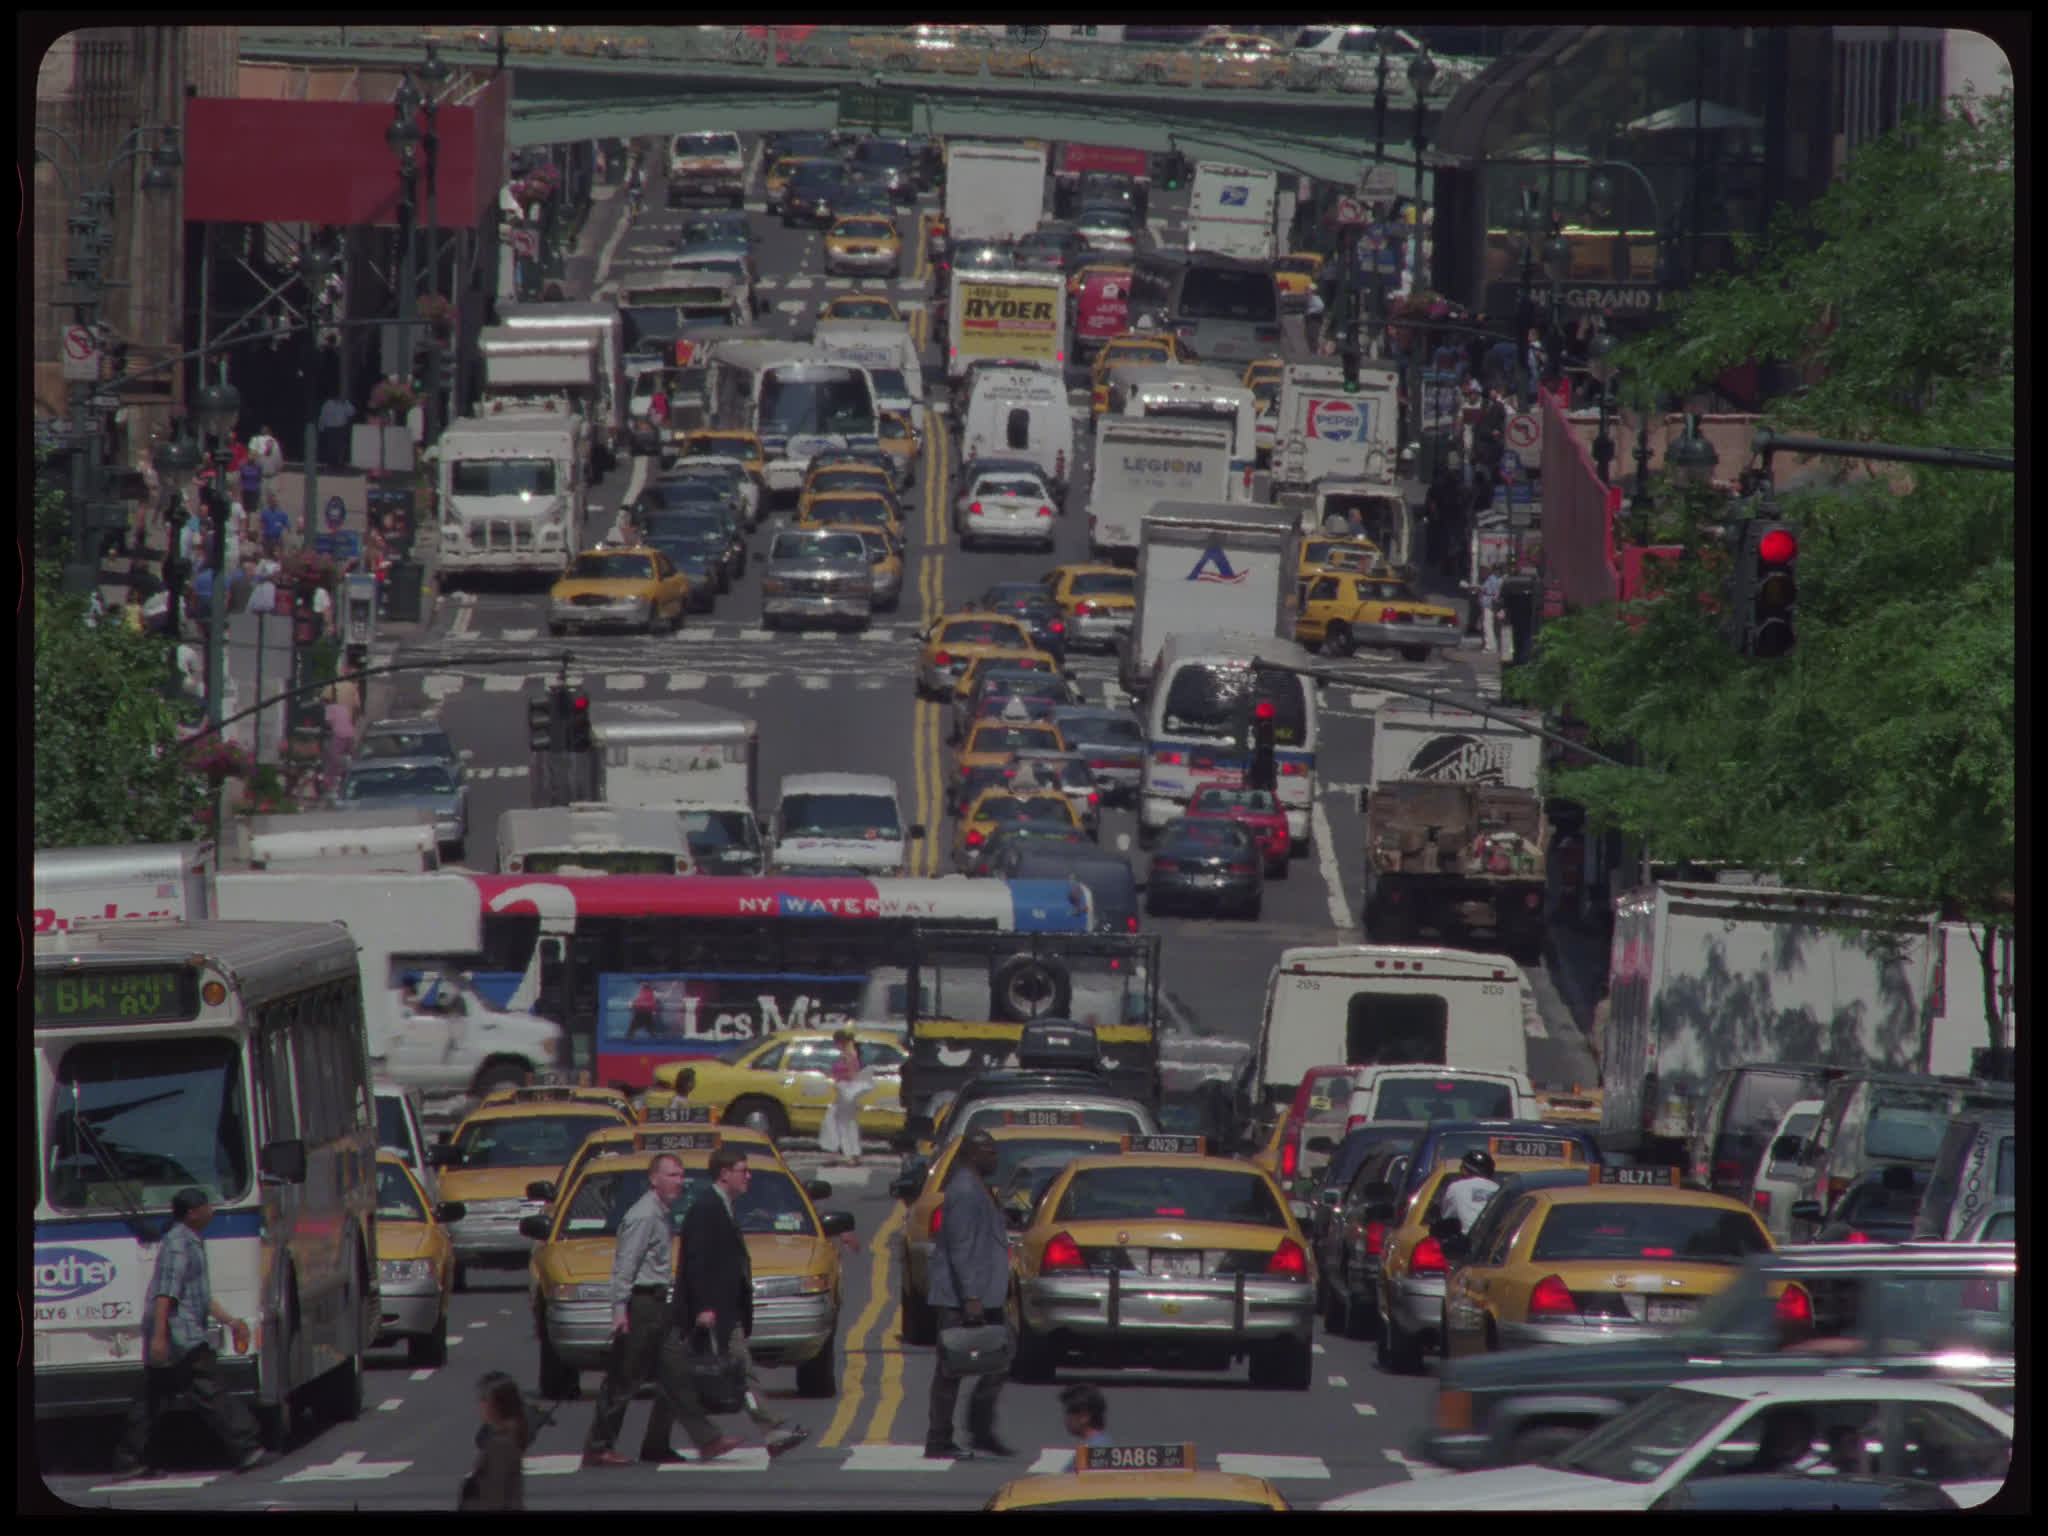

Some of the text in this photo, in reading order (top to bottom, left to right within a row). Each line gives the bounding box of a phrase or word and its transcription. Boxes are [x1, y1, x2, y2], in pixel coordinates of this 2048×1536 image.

[1567, 288, 1650, 309] GRAND
[966, 299, 1053, 319] RYDER
[1122, 457, 1203, 473] LEGION
[739, 897, 936, 915] NY WATERWAY
[1618, 1170, 1654, 1184] 8L71
[1111, 1447, 1158, 1467] 9A86
